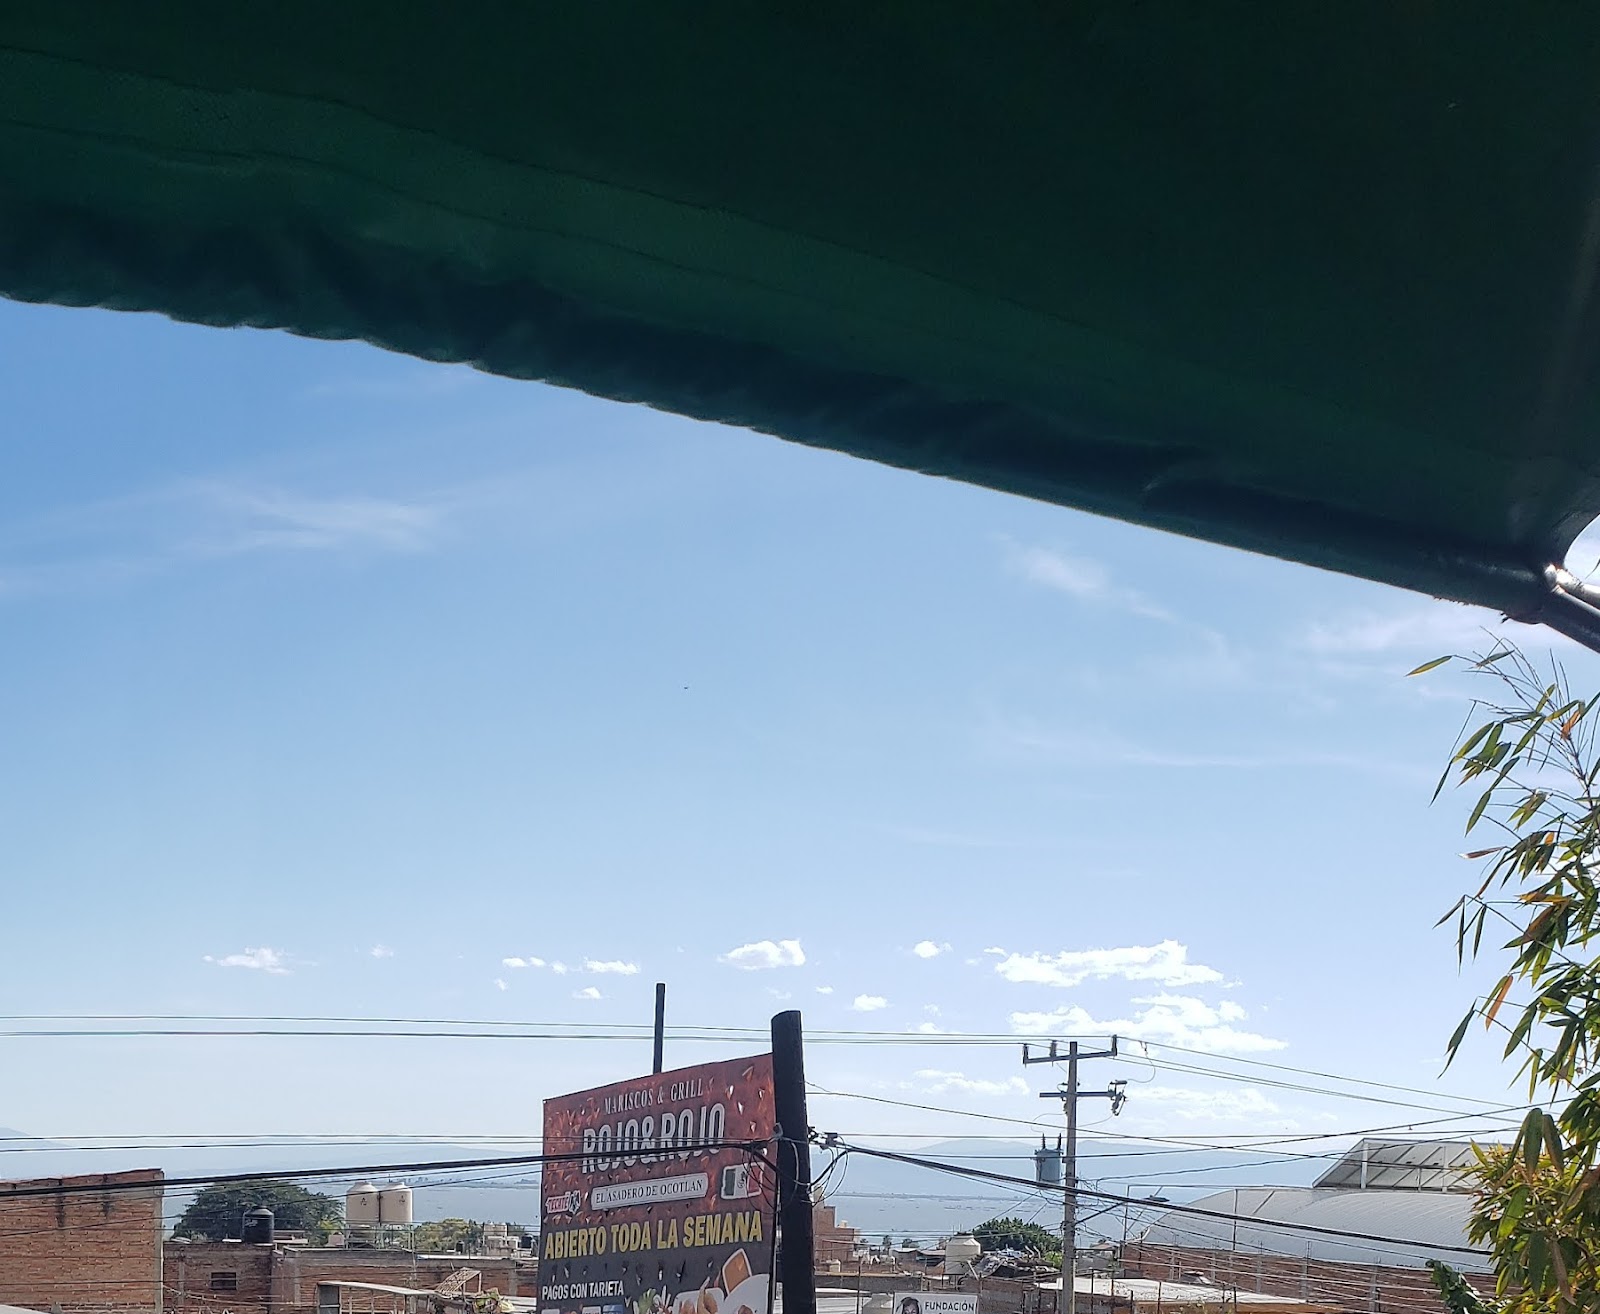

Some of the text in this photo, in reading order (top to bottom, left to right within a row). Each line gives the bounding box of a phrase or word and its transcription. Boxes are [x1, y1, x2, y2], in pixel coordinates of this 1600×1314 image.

[604, 1088, 654, 1115] MARISCOS
[670, 1078, 704, 1102] GRILL
[595, 1178, 704, 1204] EL ASADERO DE OCOTLAN
[545, 1210, 763, 1260] ABIERTO TODA LA SEMANA
[542, 1280, 624, 1300] PAGOS CON TARJETA
[924, 1300, 975, 1312] FUNDACIÓN
